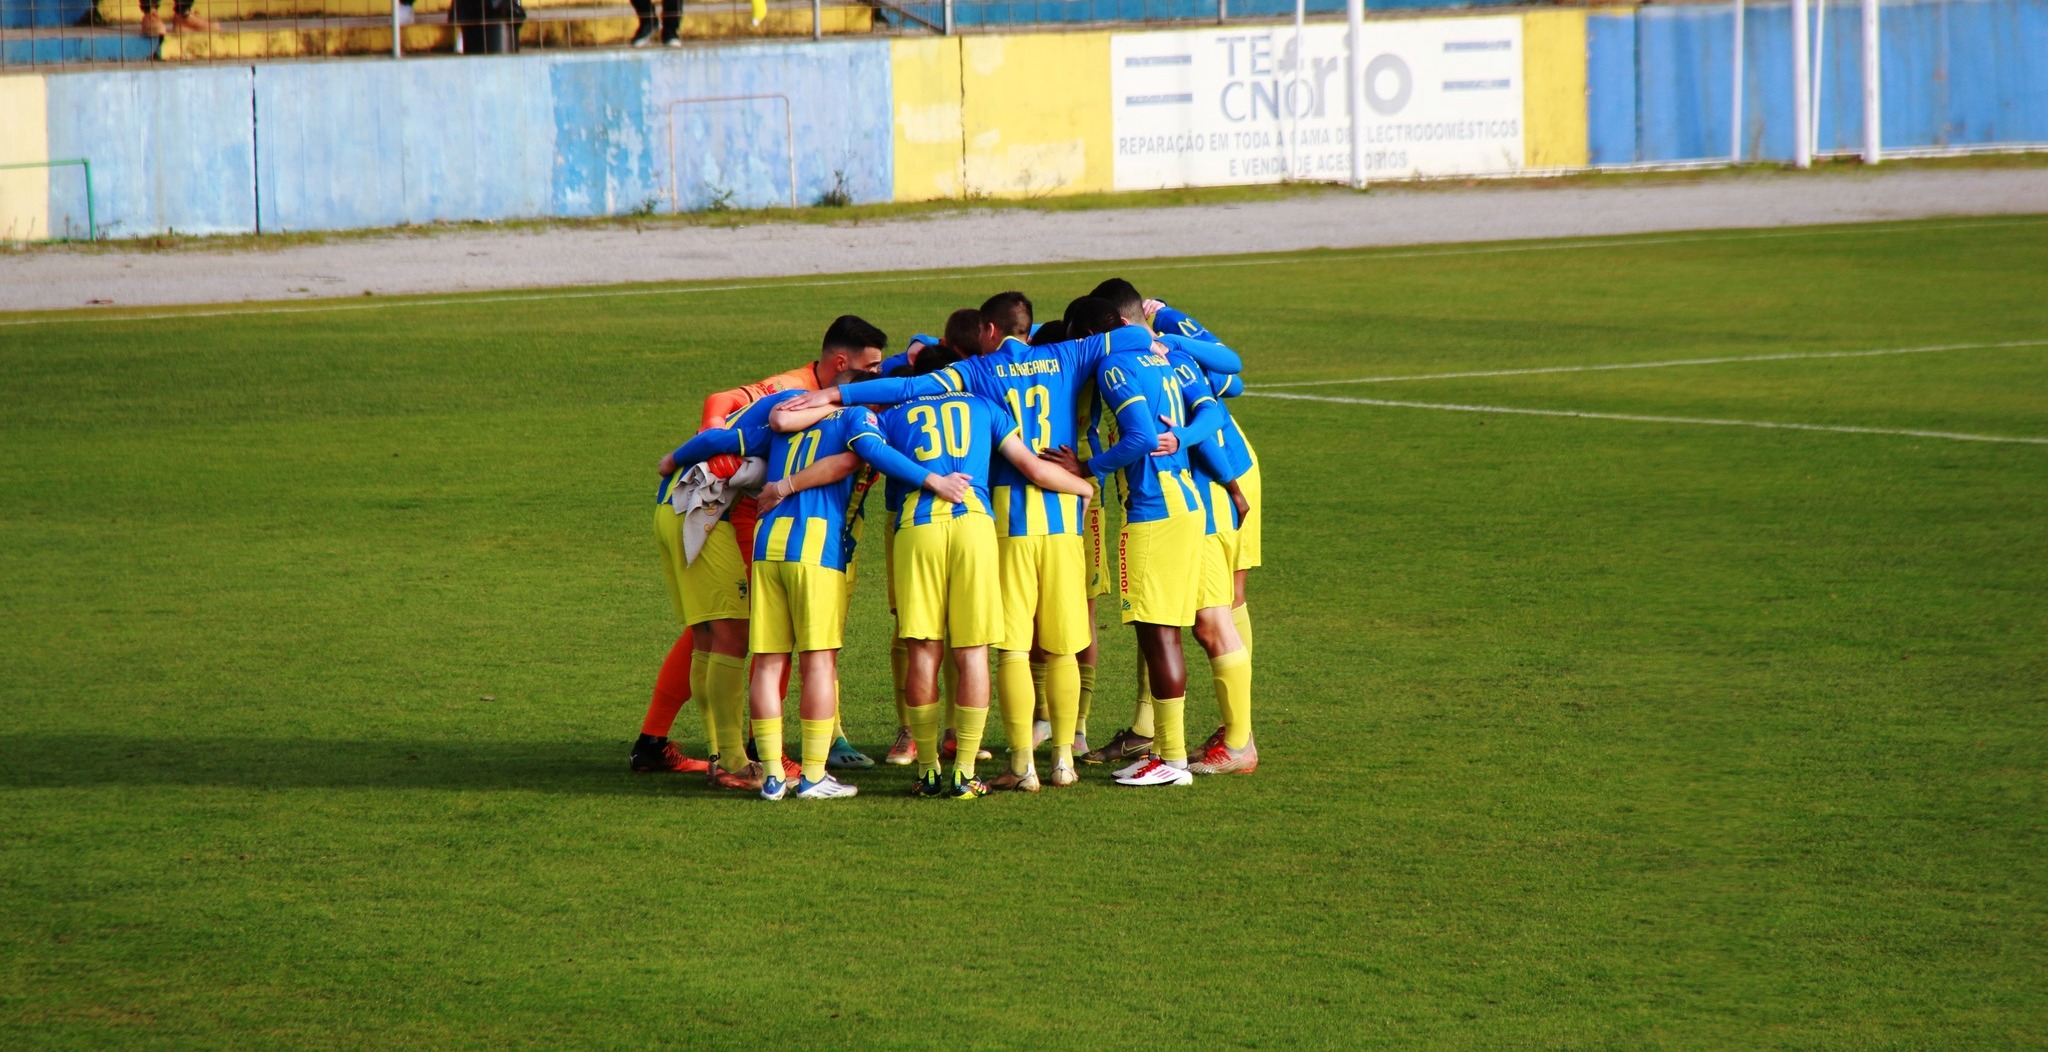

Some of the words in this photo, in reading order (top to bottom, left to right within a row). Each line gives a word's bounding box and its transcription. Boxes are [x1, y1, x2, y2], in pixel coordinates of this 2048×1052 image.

[1216, 35, 1272, 76] TE
[1119, 131, 1205, 157] REPARAÇÃO
[1210, 132, 1229, 151] EM
[1235, 131, 1270, 149] TODA
[1276, 131, 1284, 147] A
[1364, 119, 1518, 144] LECTRODOMÉSTICOS
[1229, 158, 1237, 177] E
[1242, 156, 1288, 176] VENDA
[906, 401, 971, 462] 30
[1004, 384, 1051, 455] 13
[1090, 509, 1101, 568] Fepronor
[1119, 532, 1129, 594] Fepronor
